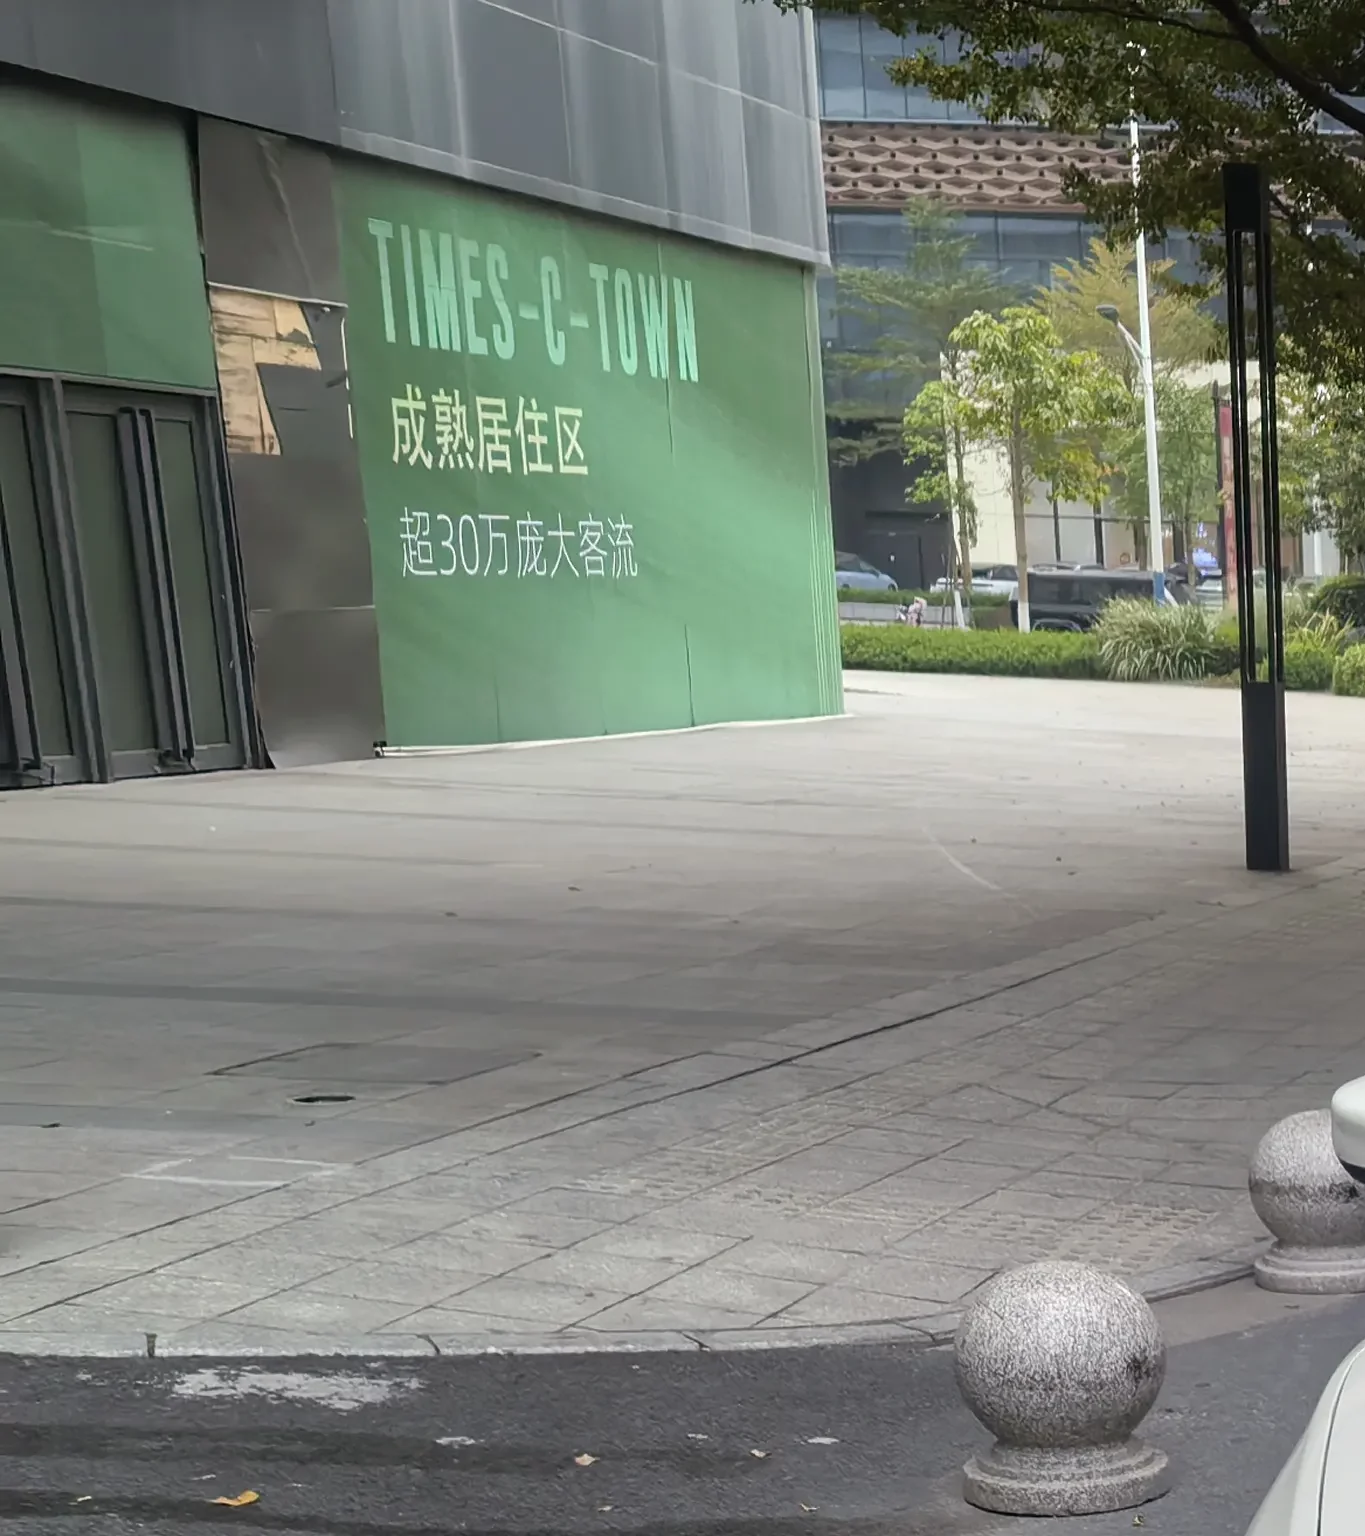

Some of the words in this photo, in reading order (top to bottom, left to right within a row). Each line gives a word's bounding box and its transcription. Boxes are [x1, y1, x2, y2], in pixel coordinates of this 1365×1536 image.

[368, 217, 699, 382] TIMES-C-TOWN
[391, 383, 589, 475] 成熟居住区
[400, 506, 639, 579] 超30万庞大客流
